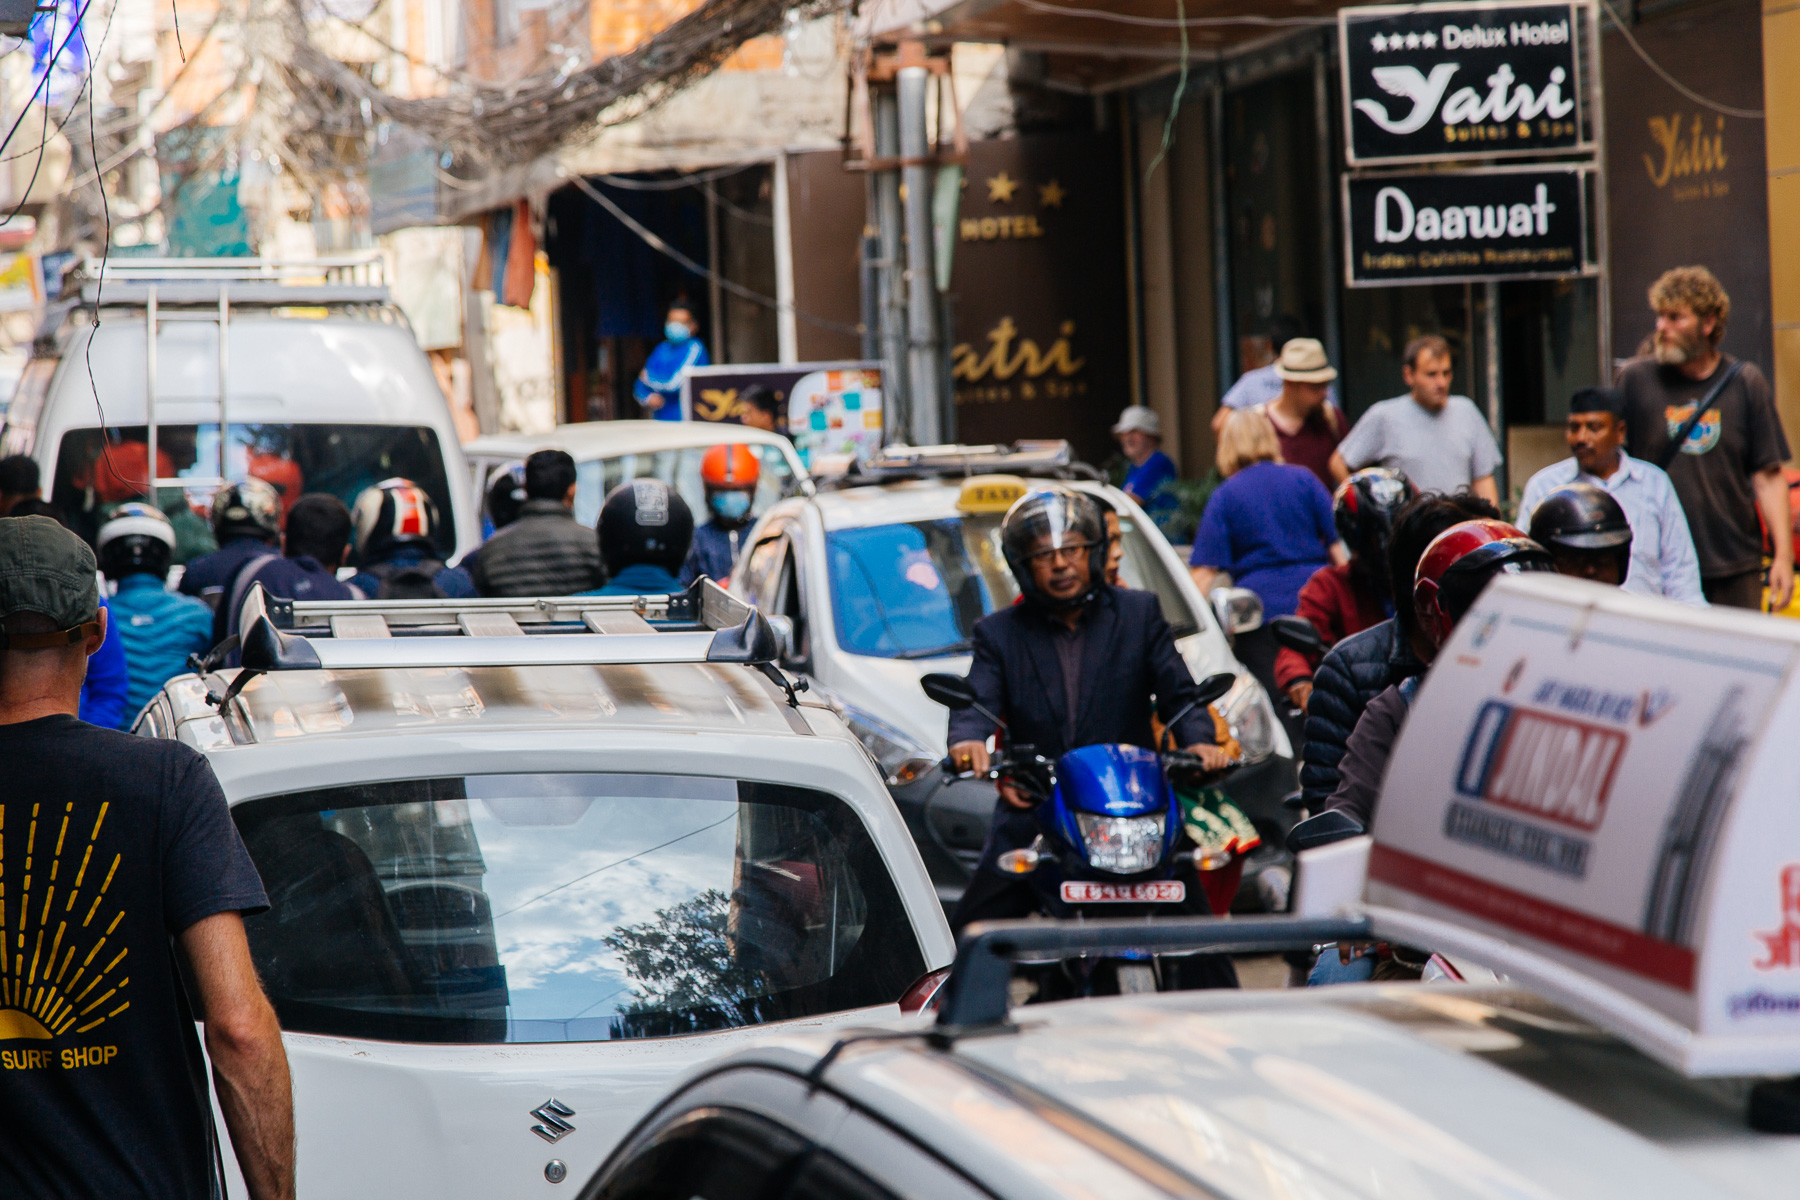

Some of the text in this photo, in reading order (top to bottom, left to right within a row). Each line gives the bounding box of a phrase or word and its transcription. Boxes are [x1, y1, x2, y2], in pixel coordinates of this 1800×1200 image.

[1442, 19, 1569, 50] Delux Hotel
[1353, 62, 1575, 135] Yatri
[960, 215, 1044, 241] HOTEL
[1374, 182, 1557, 244] Daawat
[952, 315, 1087, 382] atri
[1, 1045, 118, 1069] SURF SHOP
